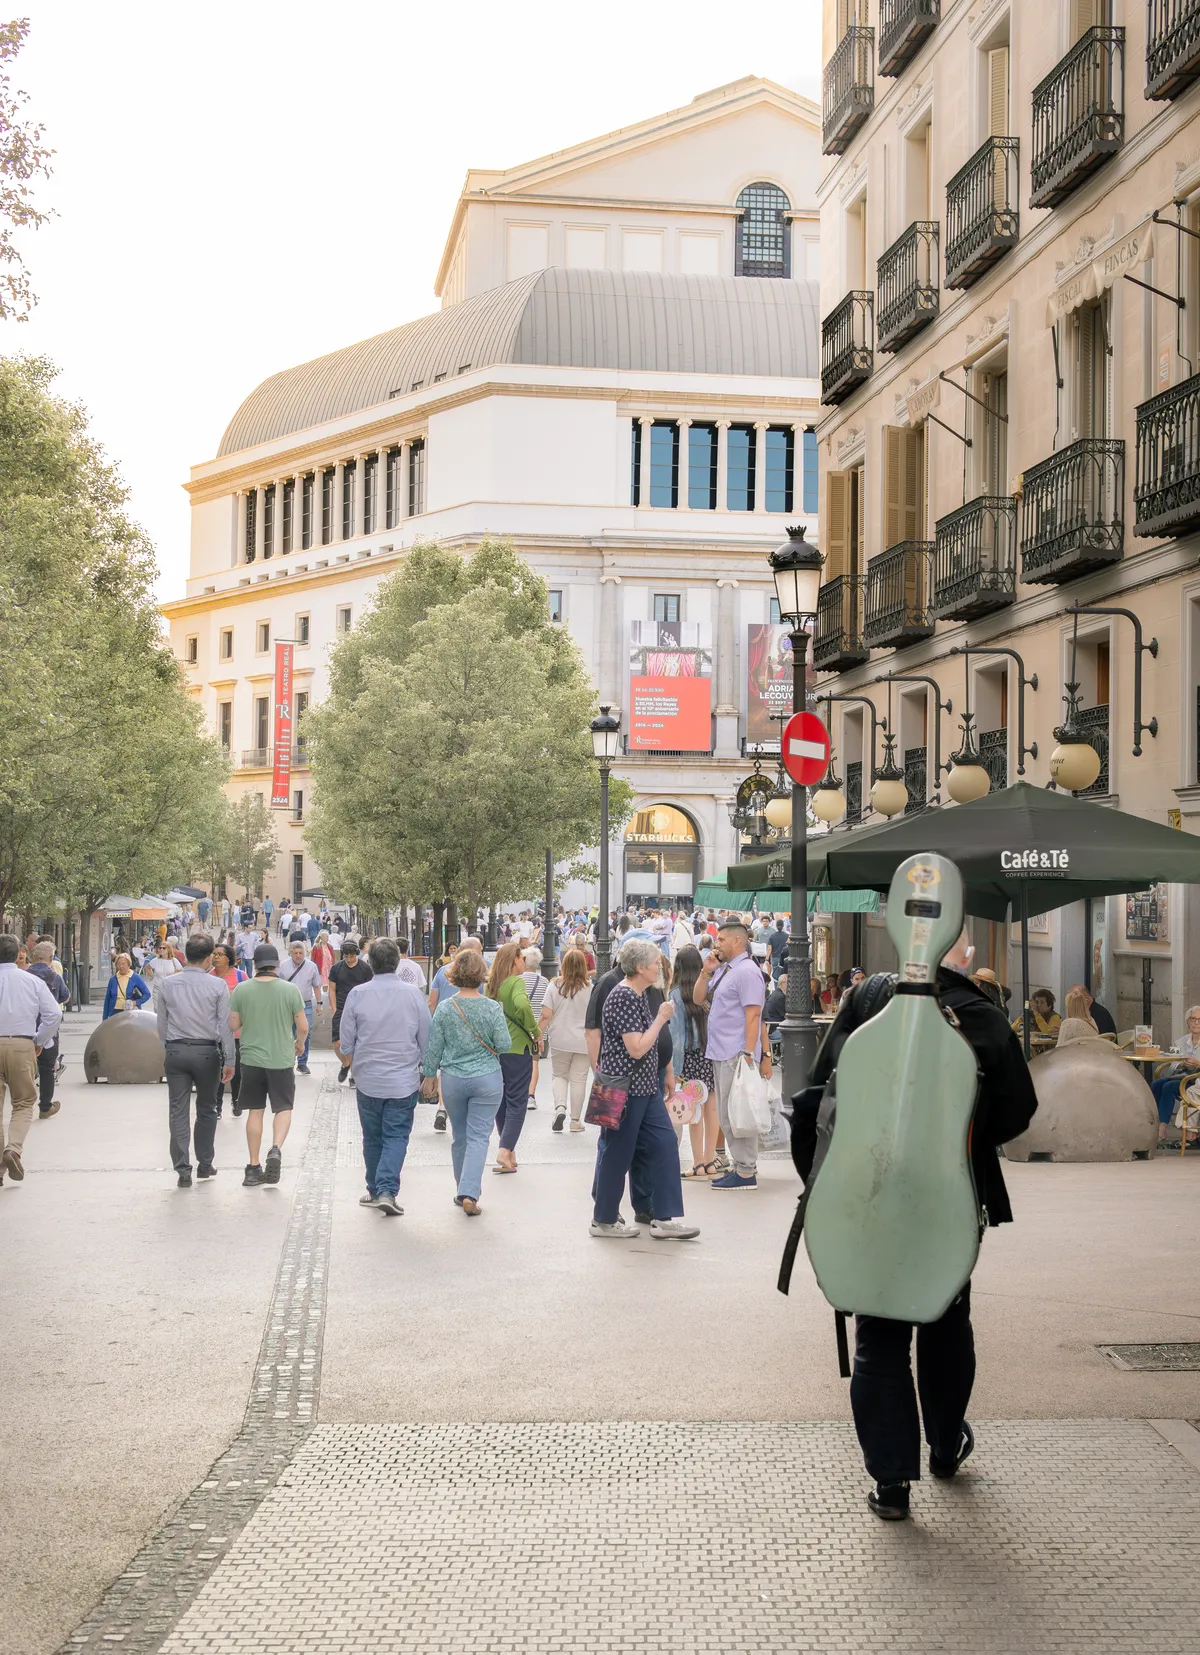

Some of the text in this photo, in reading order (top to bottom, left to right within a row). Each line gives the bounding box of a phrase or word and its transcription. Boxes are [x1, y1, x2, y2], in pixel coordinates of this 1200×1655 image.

[1057, 238, 1139, 308] FISCAL FINCAS
[759, 692, 816, 700] LECOUVUR
[626, 833, 694, 843] STARBUCKS
